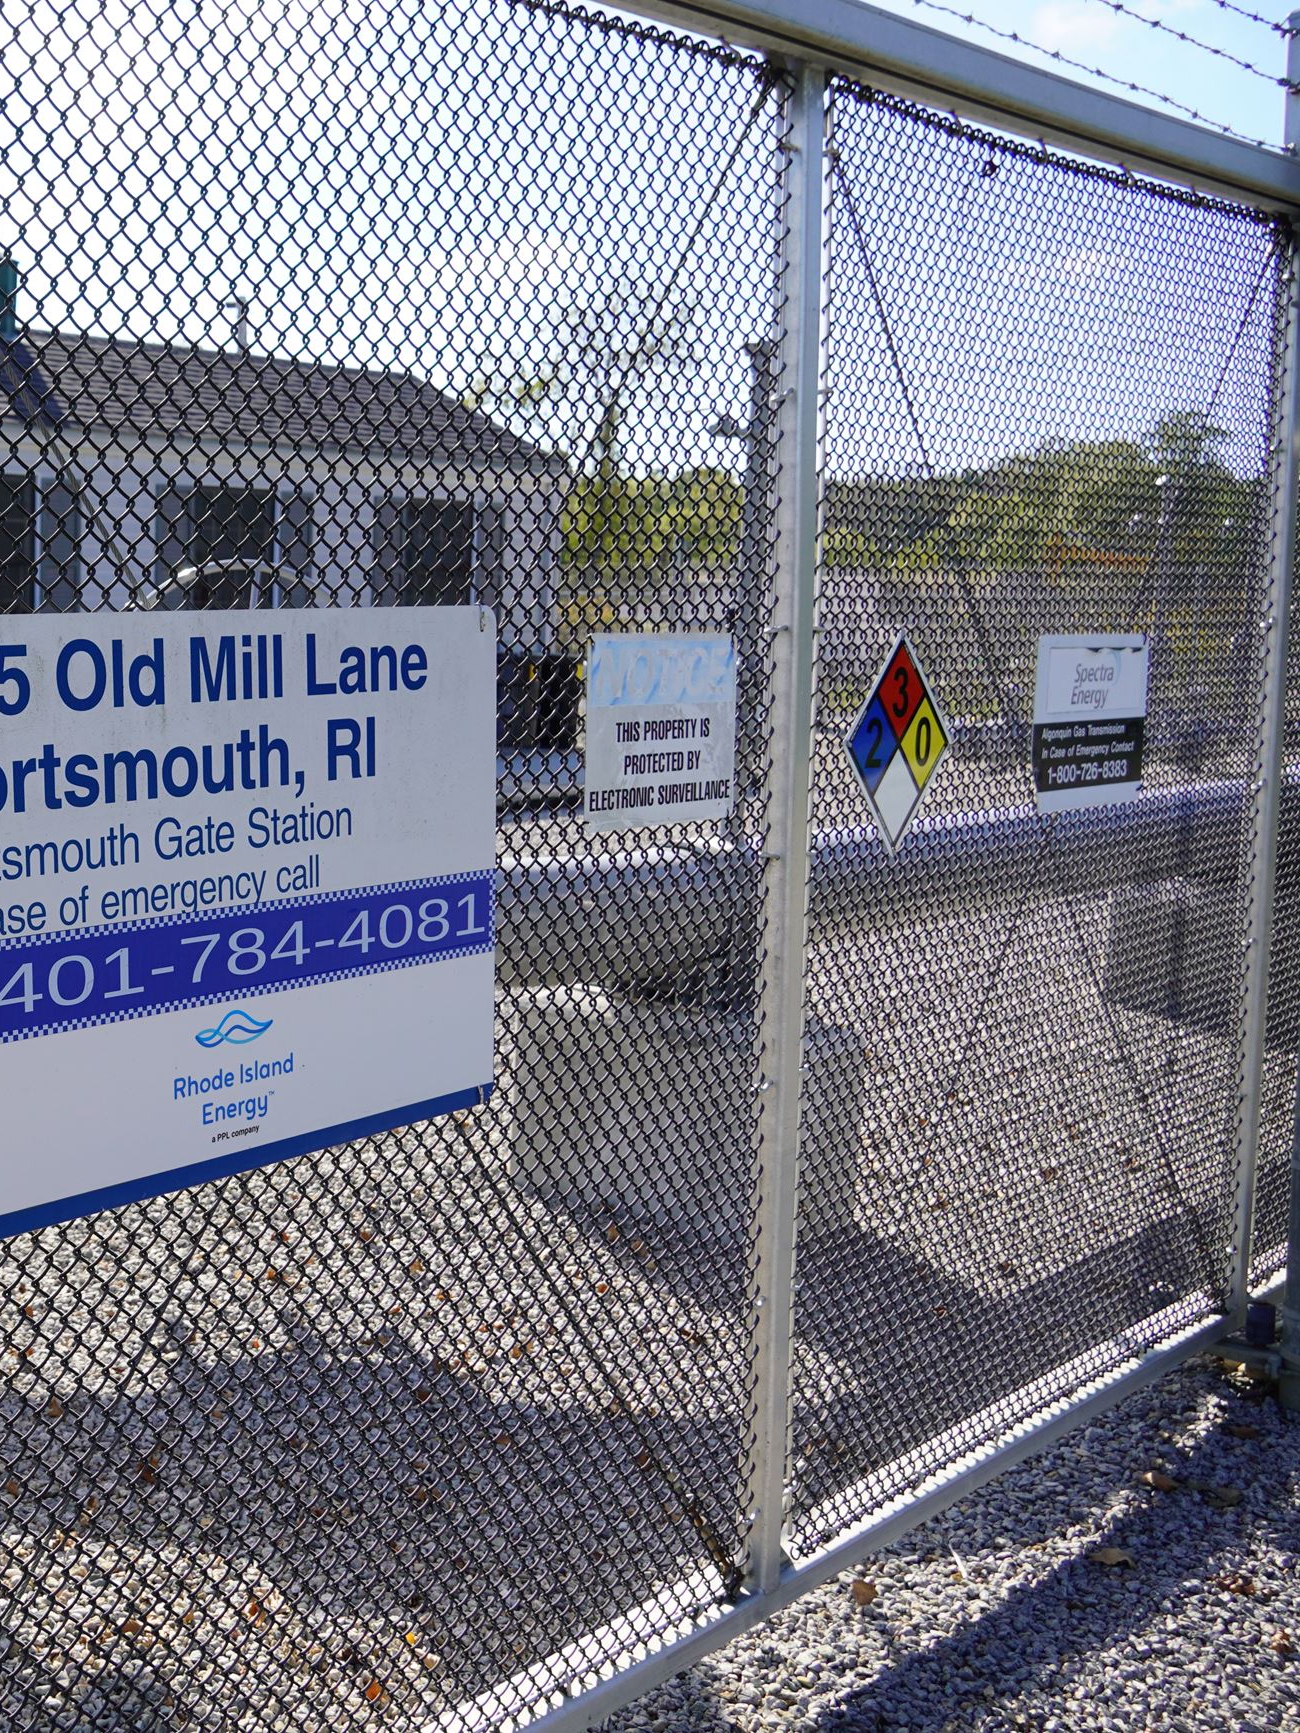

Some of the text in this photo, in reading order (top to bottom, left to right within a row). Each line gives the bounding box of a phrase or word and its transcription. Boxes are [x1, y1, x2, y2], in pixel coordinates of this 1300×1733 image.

[56, 637, 166, 712] Old
[189, 634, 284, 703] Mill
[306, 633, 428, 696] Lane
[1074, 664, 1114, 687] Spectra
[892, 667, 909, 718] 3
[1071, 686, 1108, 709] Energy
[616, 717, 710, 743] THIS PROPERTY IS
[865, 718, 883, 768] 2
[915, 716, 931, 767] 0
[1041, 723, 1125, 742] Algonquin Gas Transmission
[327, 716, 376, 782] RI
[624, 750, 701, 776] PROTECTED BY
[1041, 741, 1135, 759] In Case of Emergency Contact
[1047, 759, 1128, 785] 1-800-726-8383
[589, 779, 731, 812] ELECTRONIC SURVEILLANCE
[154, 816, 235, 861] Gate
[247, 802, 352, 849] Station
[60, 885, 89, 925] of
[101, 871, 267, 914] emergency
[276, 854, 321, 894] call
[173, 1052, 294, 1100] Rhode Island
[211, 1124, 260, 1143] a PPL company
